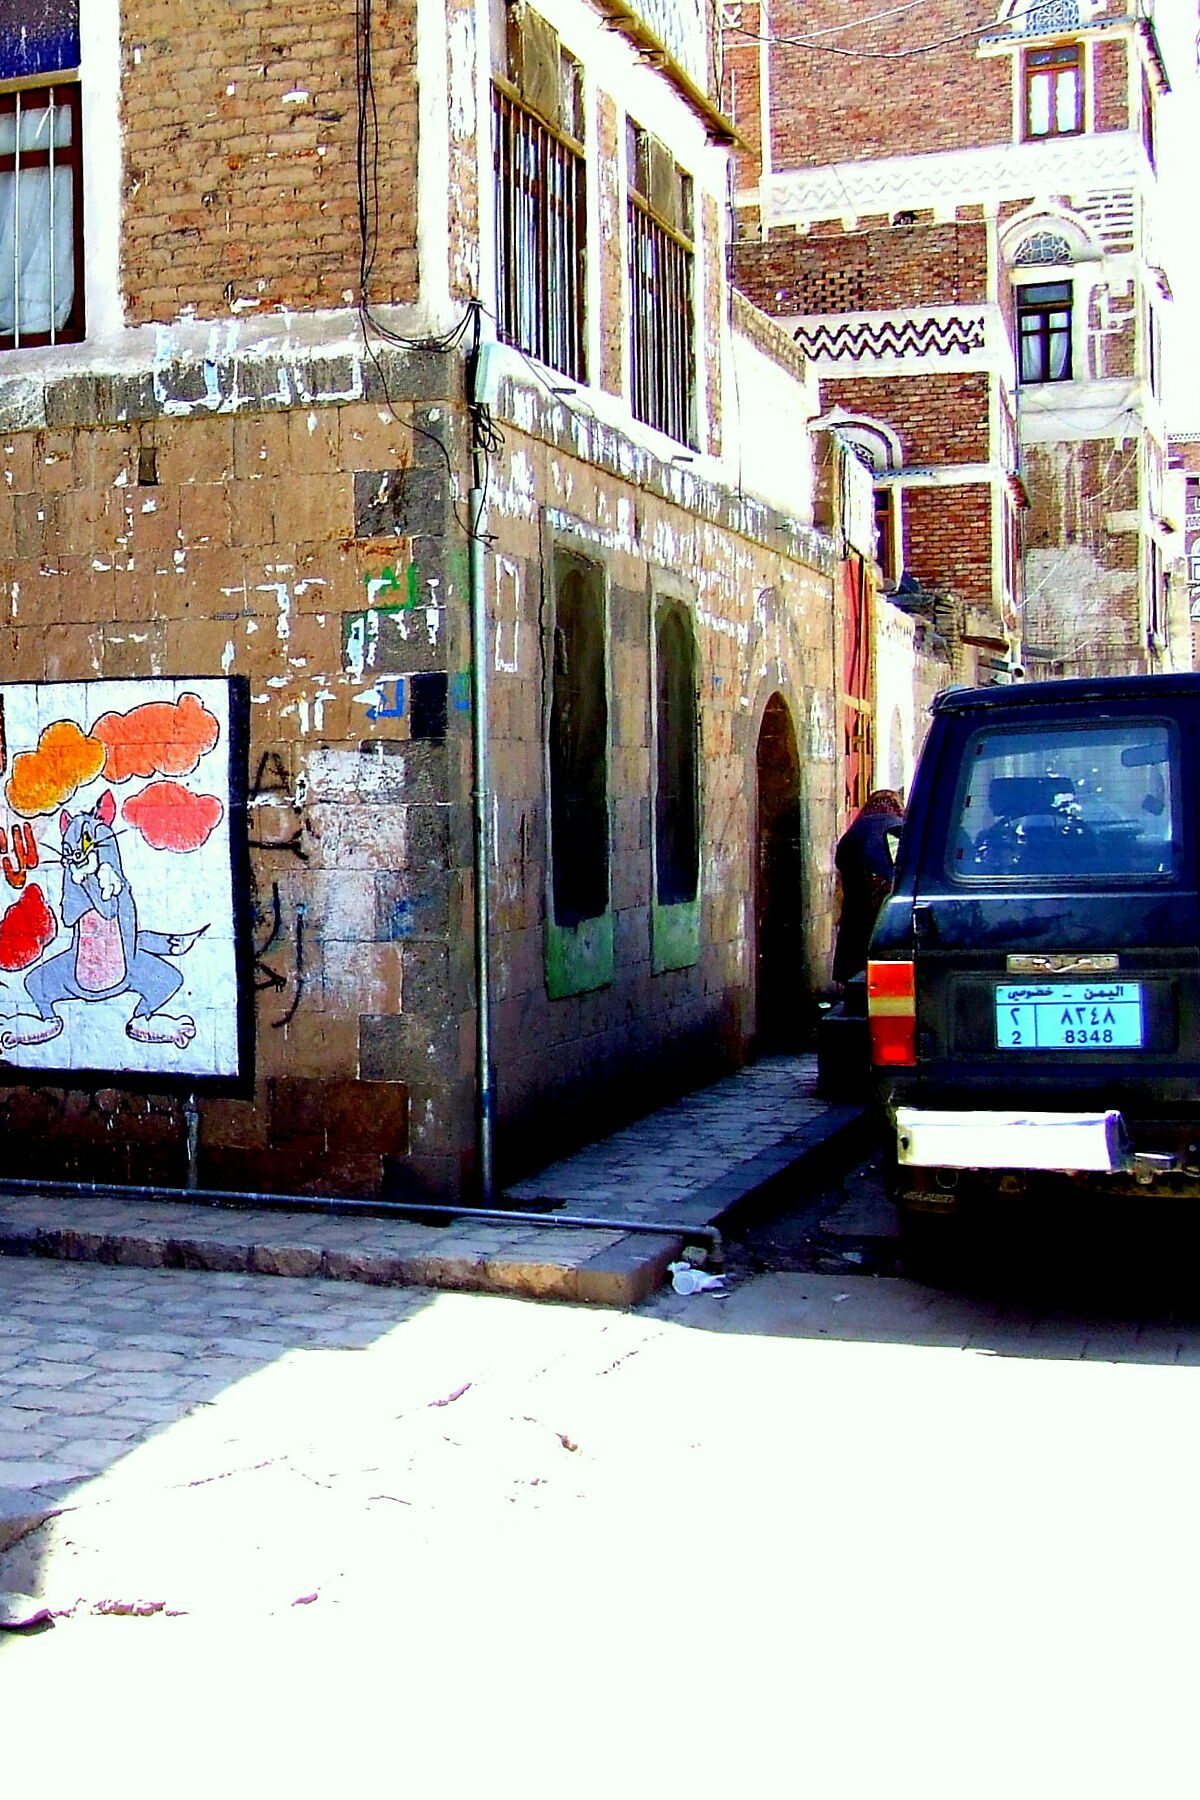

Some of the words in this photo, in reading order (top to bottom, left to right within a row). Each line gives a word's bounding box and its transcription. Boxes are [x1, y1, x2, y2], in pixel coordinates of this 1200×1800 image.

[1084, 985, 1124, 1001] اليمن
[1010, 1007, 1021, 1026] ٢
[1061, 1007, 1116, 1026] ٨٣٤٨
[1011, 1030, 1022, 1045] 2
[1064, 1029, 1113, 1044] 8348
